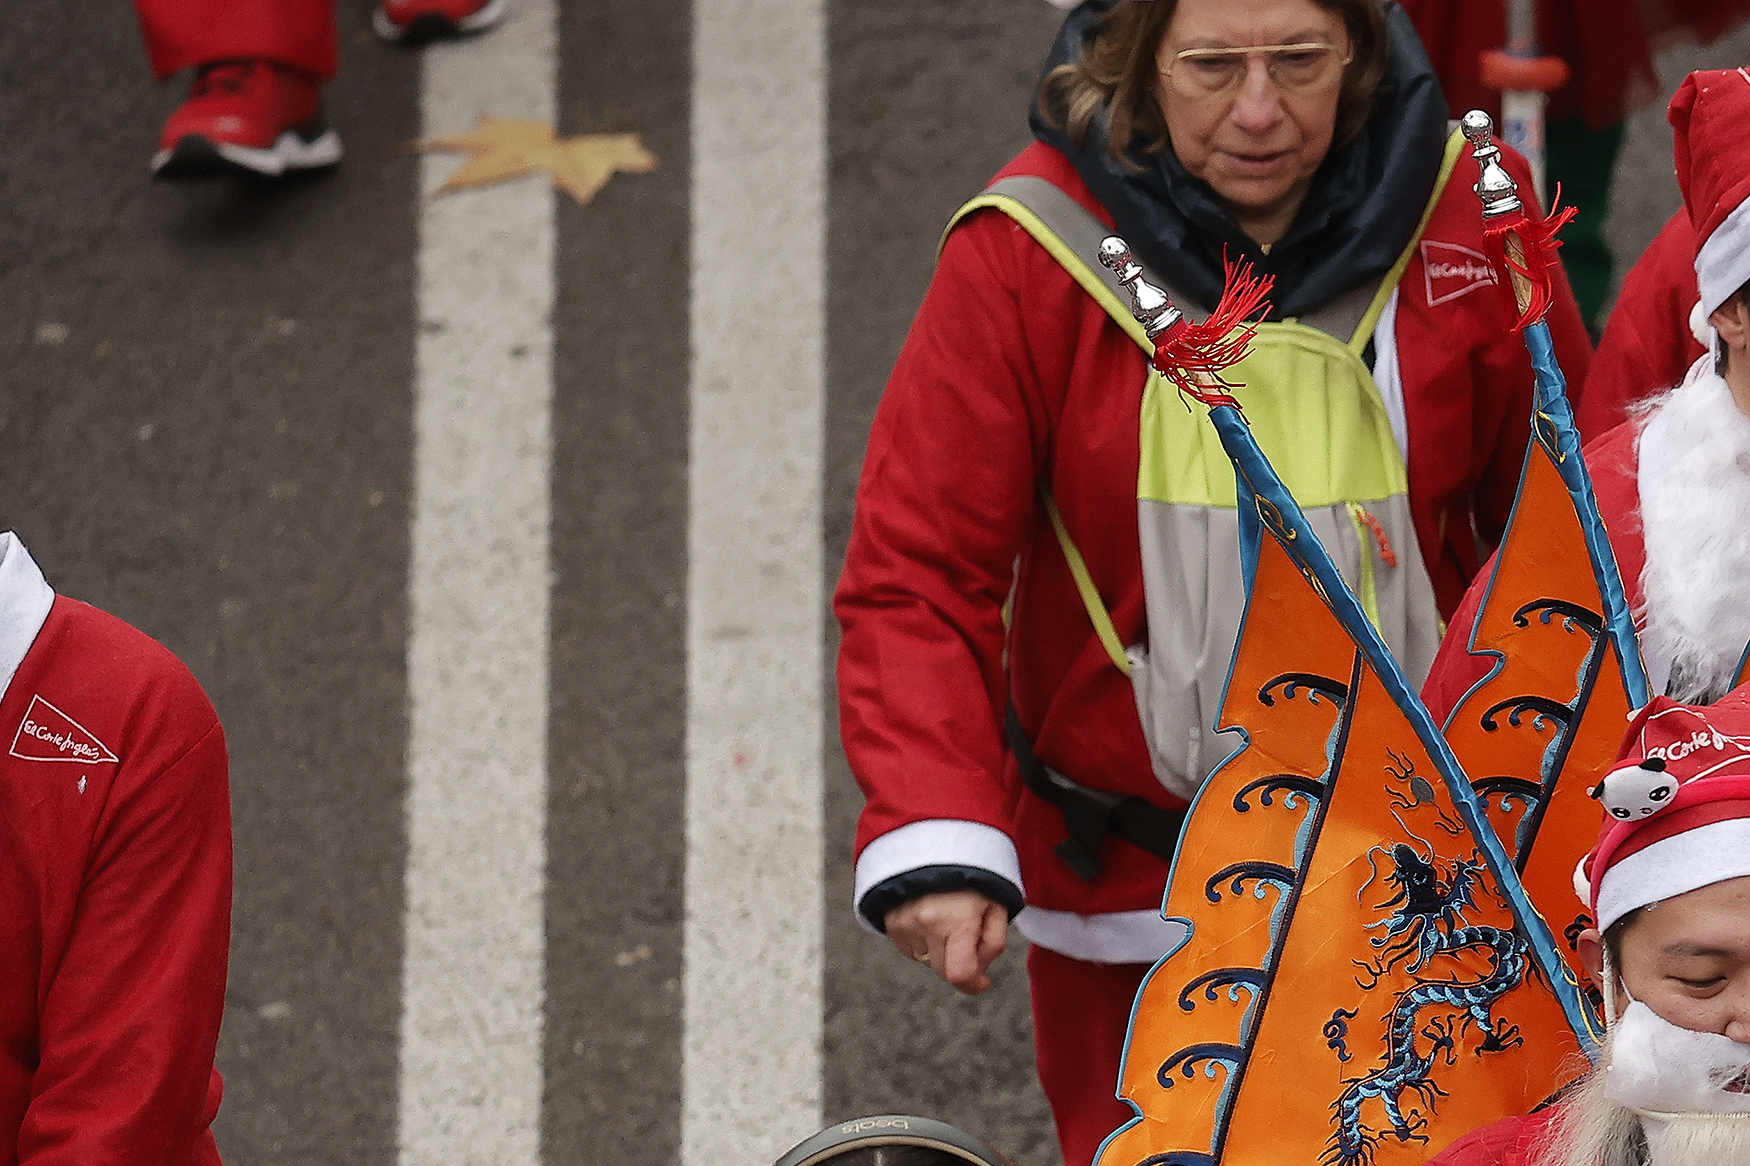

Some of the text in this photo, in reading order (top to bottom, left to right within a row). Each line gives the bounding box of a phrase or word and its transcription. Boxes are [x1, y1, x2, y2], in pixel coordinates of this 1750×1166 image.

[23, 720, 38, 736] El
[36, 726, 63, 746] Corte
[1666, 731, 1712, 761] Corte
